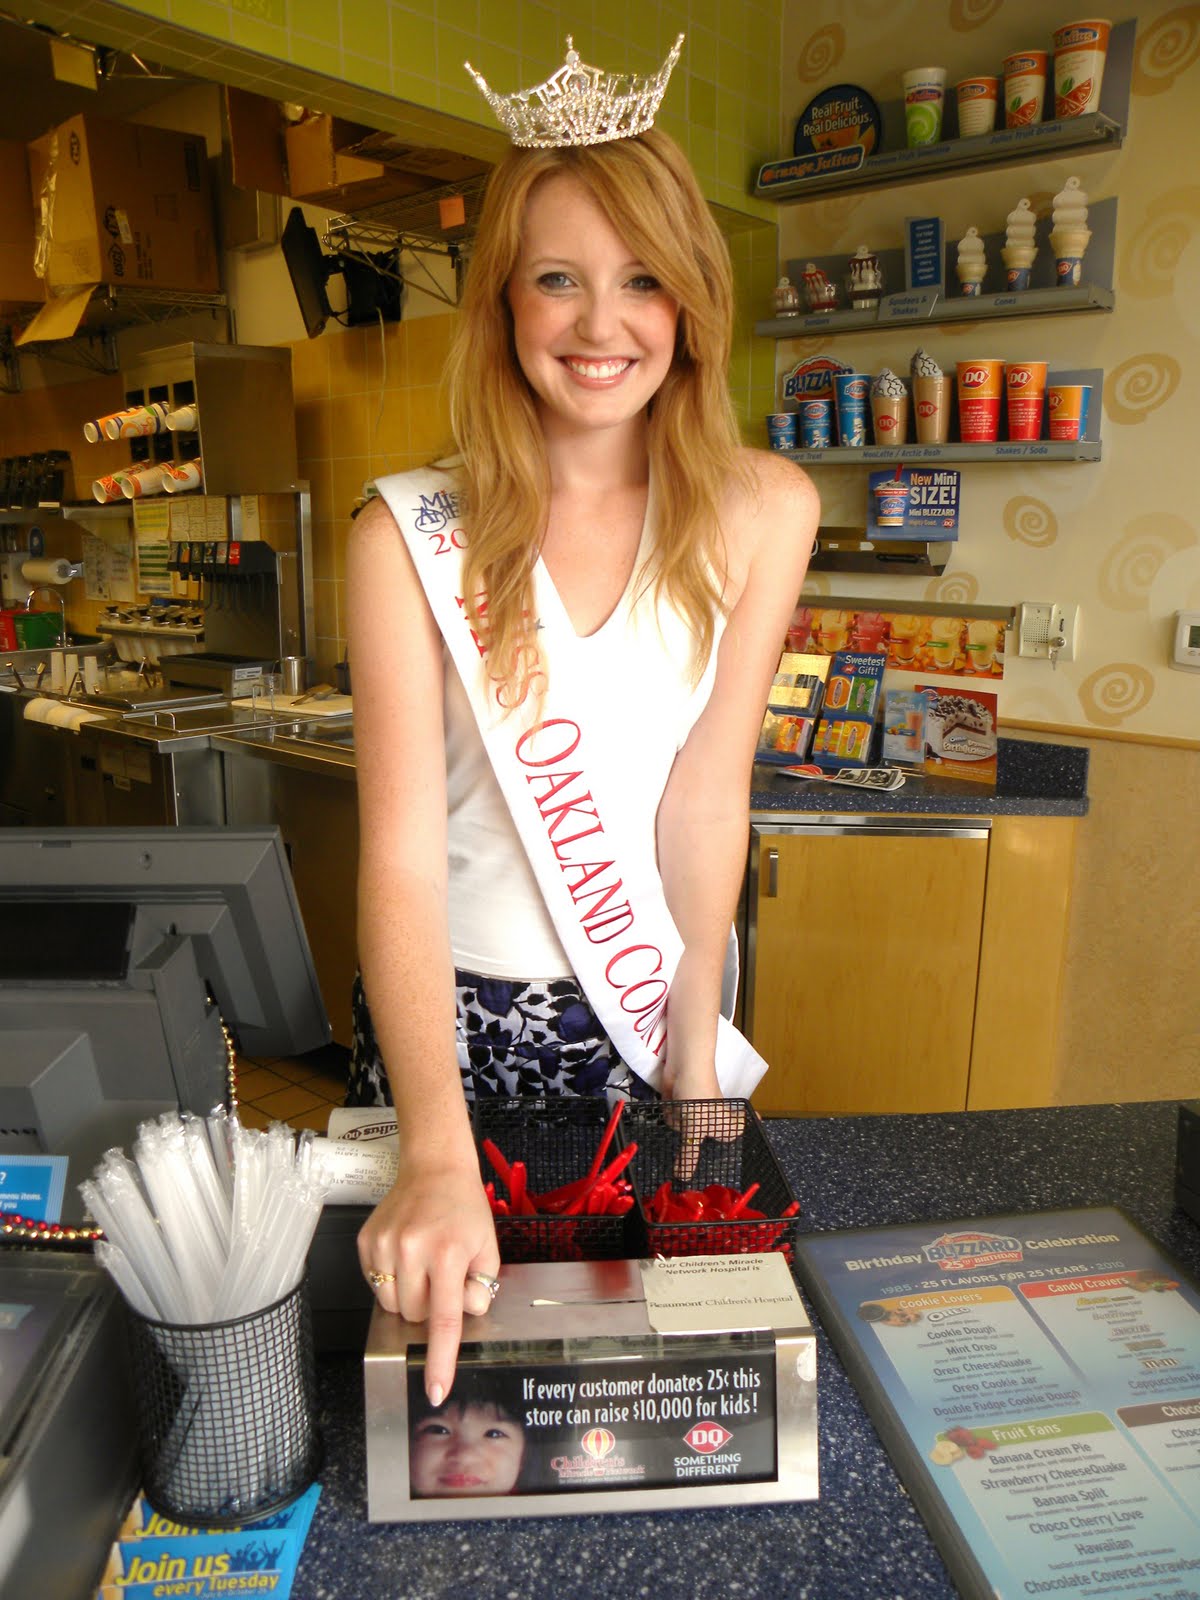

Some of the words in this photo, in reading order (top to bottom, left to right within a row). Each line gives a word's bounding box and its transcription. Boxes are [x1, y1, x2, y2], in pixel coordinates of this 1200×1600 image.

[812, 102, 832, 119] Real
[835, 96, 862, 114] Fruit.
[803, 122, 824, 137] Real
[825, 113, 872, 132] Delicious.
[814, 153, 859, 172] Julius
[965, 372, 985, 384] DQ
[1009, 372, 1027, 384] DQ
[920, 404, 934, 415] DQ
[879, 418, 895, 426] DQ
[995, 447, 1021, 455] Shakes
[1030, 446, 1048, 455] Soda
[910, 473, 932, 486] New
[934, 472, 957, 486] Mini
[910, 486, 956, 505] SIZE!
[923, 508, 955, 517] BLIZZARD
[844, 655, 885, 667] Sweetest
[858, 666, 878, 676] Gift!
[516, 718, 635, 944] OAKLAND
[363, 1124, 398, 1136] ulius
[4, 1202, 17, 1210] you
[845, 1253, 923, 1271] Birthday
[928, 1238, 1020, 1262] BLIZZARD
[1025, 1233, 1120, 1250] Celebration
[974, 1252, 1018, 1264] BIRTHDAY
[666, 1267, 707, 1275] Network
[710, 1265, 750, 1274] Hospital
[679, 1260, 726, 1268] Children's
[880, 1283, 913, 1295] 1985
[921, 1280, 939, 1289] 25
[942, 1274, 997, 1287] FLAVORS
[1000, 1272, 1026, 1281] FOR
[1027, 1269, 1045, 1278] 25
[1046, 1265, 1089, 1276] YEARS
[1048, 1282, 1084, 1294] Candy
[1085, 1276, 1129, 1288] Cravers
[705, 1297, 752, 1306] Children's
[754, 1295, 793, 1303] Hospital
[899, 1296, 941, 1309] Cookie
[943, 1292, 983, 1305] Lovers
[927, 1329, 962, 1340] Cookie
[963, 1325, 996, 1336] Dough
[946, 1345, 971, 1355] Mint
[971, 1343, 998, 1351] Oreo
[933, 1366, 960, 1376] Oreo
[963, 1358, 1032, 1372] CheeseQuake
[523, 1378, 535, 1400] If
[537, 1383, 576, 1403] every
[579, 1379, 645, 1397] customer
[648, 1372, 703, 1394] donates
[707, 1368, 729, 1390] 25¢
[733, 1367, 761, 1389] this
[952, 1384, 979, 1393] Oreo
[981, 1378, 1017, 1389] Cookie
[1021, 1376, 1038, 1385] Jar
[1128, 1375, 1186, 1390] Cappuccino
[525, 1407, 562, 1426] store
[566, 1409, 591, 1424] can
[595, 1402, 629, 1423] raise
[633, 1396, 692, 1423] $10,000
[696, 1396, 717, 1417] for
[932, 1403, 972, 1416] Double
[974, 1400, 1007, 1411] Fudge
[1007, 1395, 1045, 1407] Cookie
[1045, 1390, 1082, 1401] Dough
[692, 1429, 724, 1447] DQ
[991, 1427, 1027, 1441] Fruit
[1029, 1423, 1063, 1437] Fans
[674, 1453, 741, 1466] SOMETHING
[989, 1452, 1034, 1465] Banana
[1033, 1446, 1071, 1458] Cream
[1071, 1443, 1092, 1454] Pie
[676, 1463, 739, 1477] DIFFERENT
[980, 1473, 1048, 1490] Strawberry
[1050, 1462, 1127, 1481] CheeseQuake
[1032, 1493, 1077, 1507] Banana
[1078, 1487, 1109, 1502] Split
[1029, 1521, 1069, 1534] Choco
[1069, 1514, 1114, 1528] Cherry
[1112, 1510, 1144, 1522] Love
[1074, 1538, 1134, 1556] Hawaiian
[115, 1553, 187, 1585] Join
[193, 1554, 231, 1577] us
[153, 1579, 205, 1598] every
[208, 1572, 279, 1591] Tuesday
[1024, 1573, 1092, 1595] Chocolate
[1091, 1565, 1147, 1583] Covered
